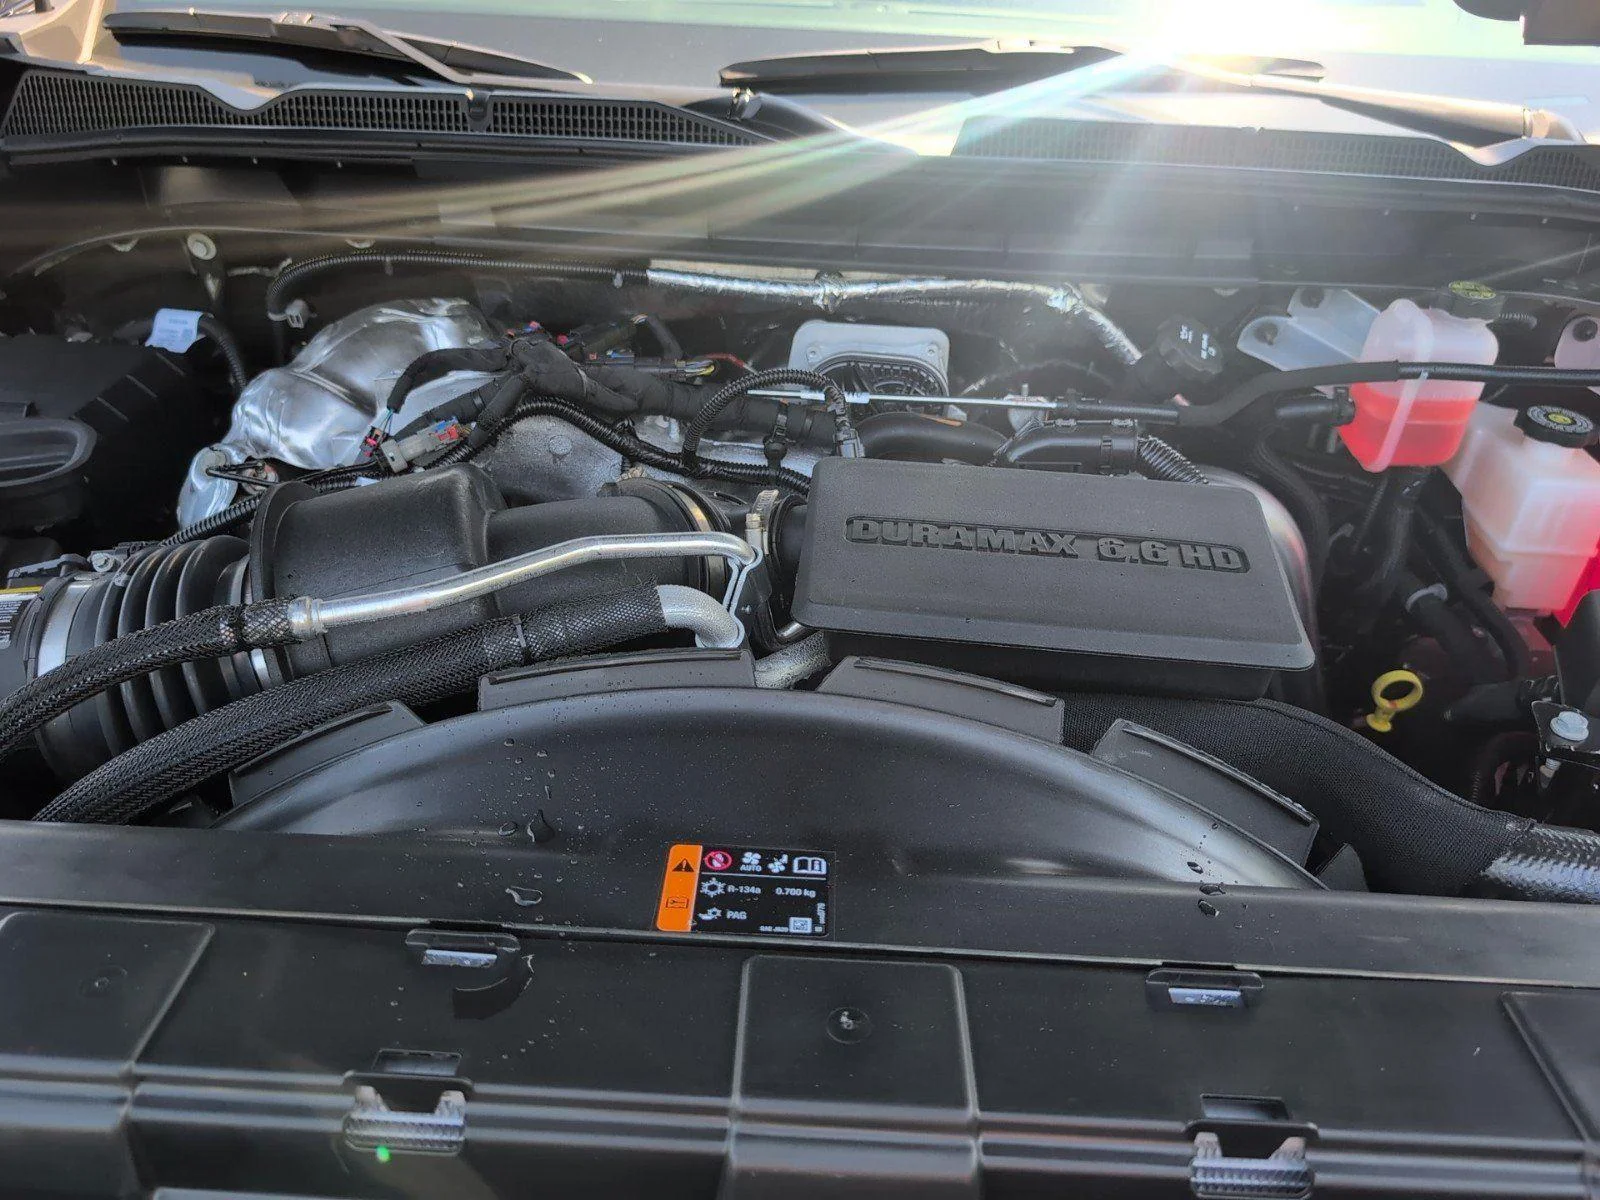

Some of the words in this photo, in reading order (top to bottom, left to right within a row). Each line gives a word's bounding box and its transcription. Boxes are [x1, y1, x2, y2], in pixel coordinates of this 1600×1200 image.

[851, 519, 1079, 558] DURAMAX
[1098, 537, 1169, 566] 6.6
[1180, 544, 1246, 573] HD
[739, 864, 762, 872] AUTO
[727, 884, 762, 894] R-134a
[803, 888, 817, 898] kg
[726, 910, 748, 920] PAG
